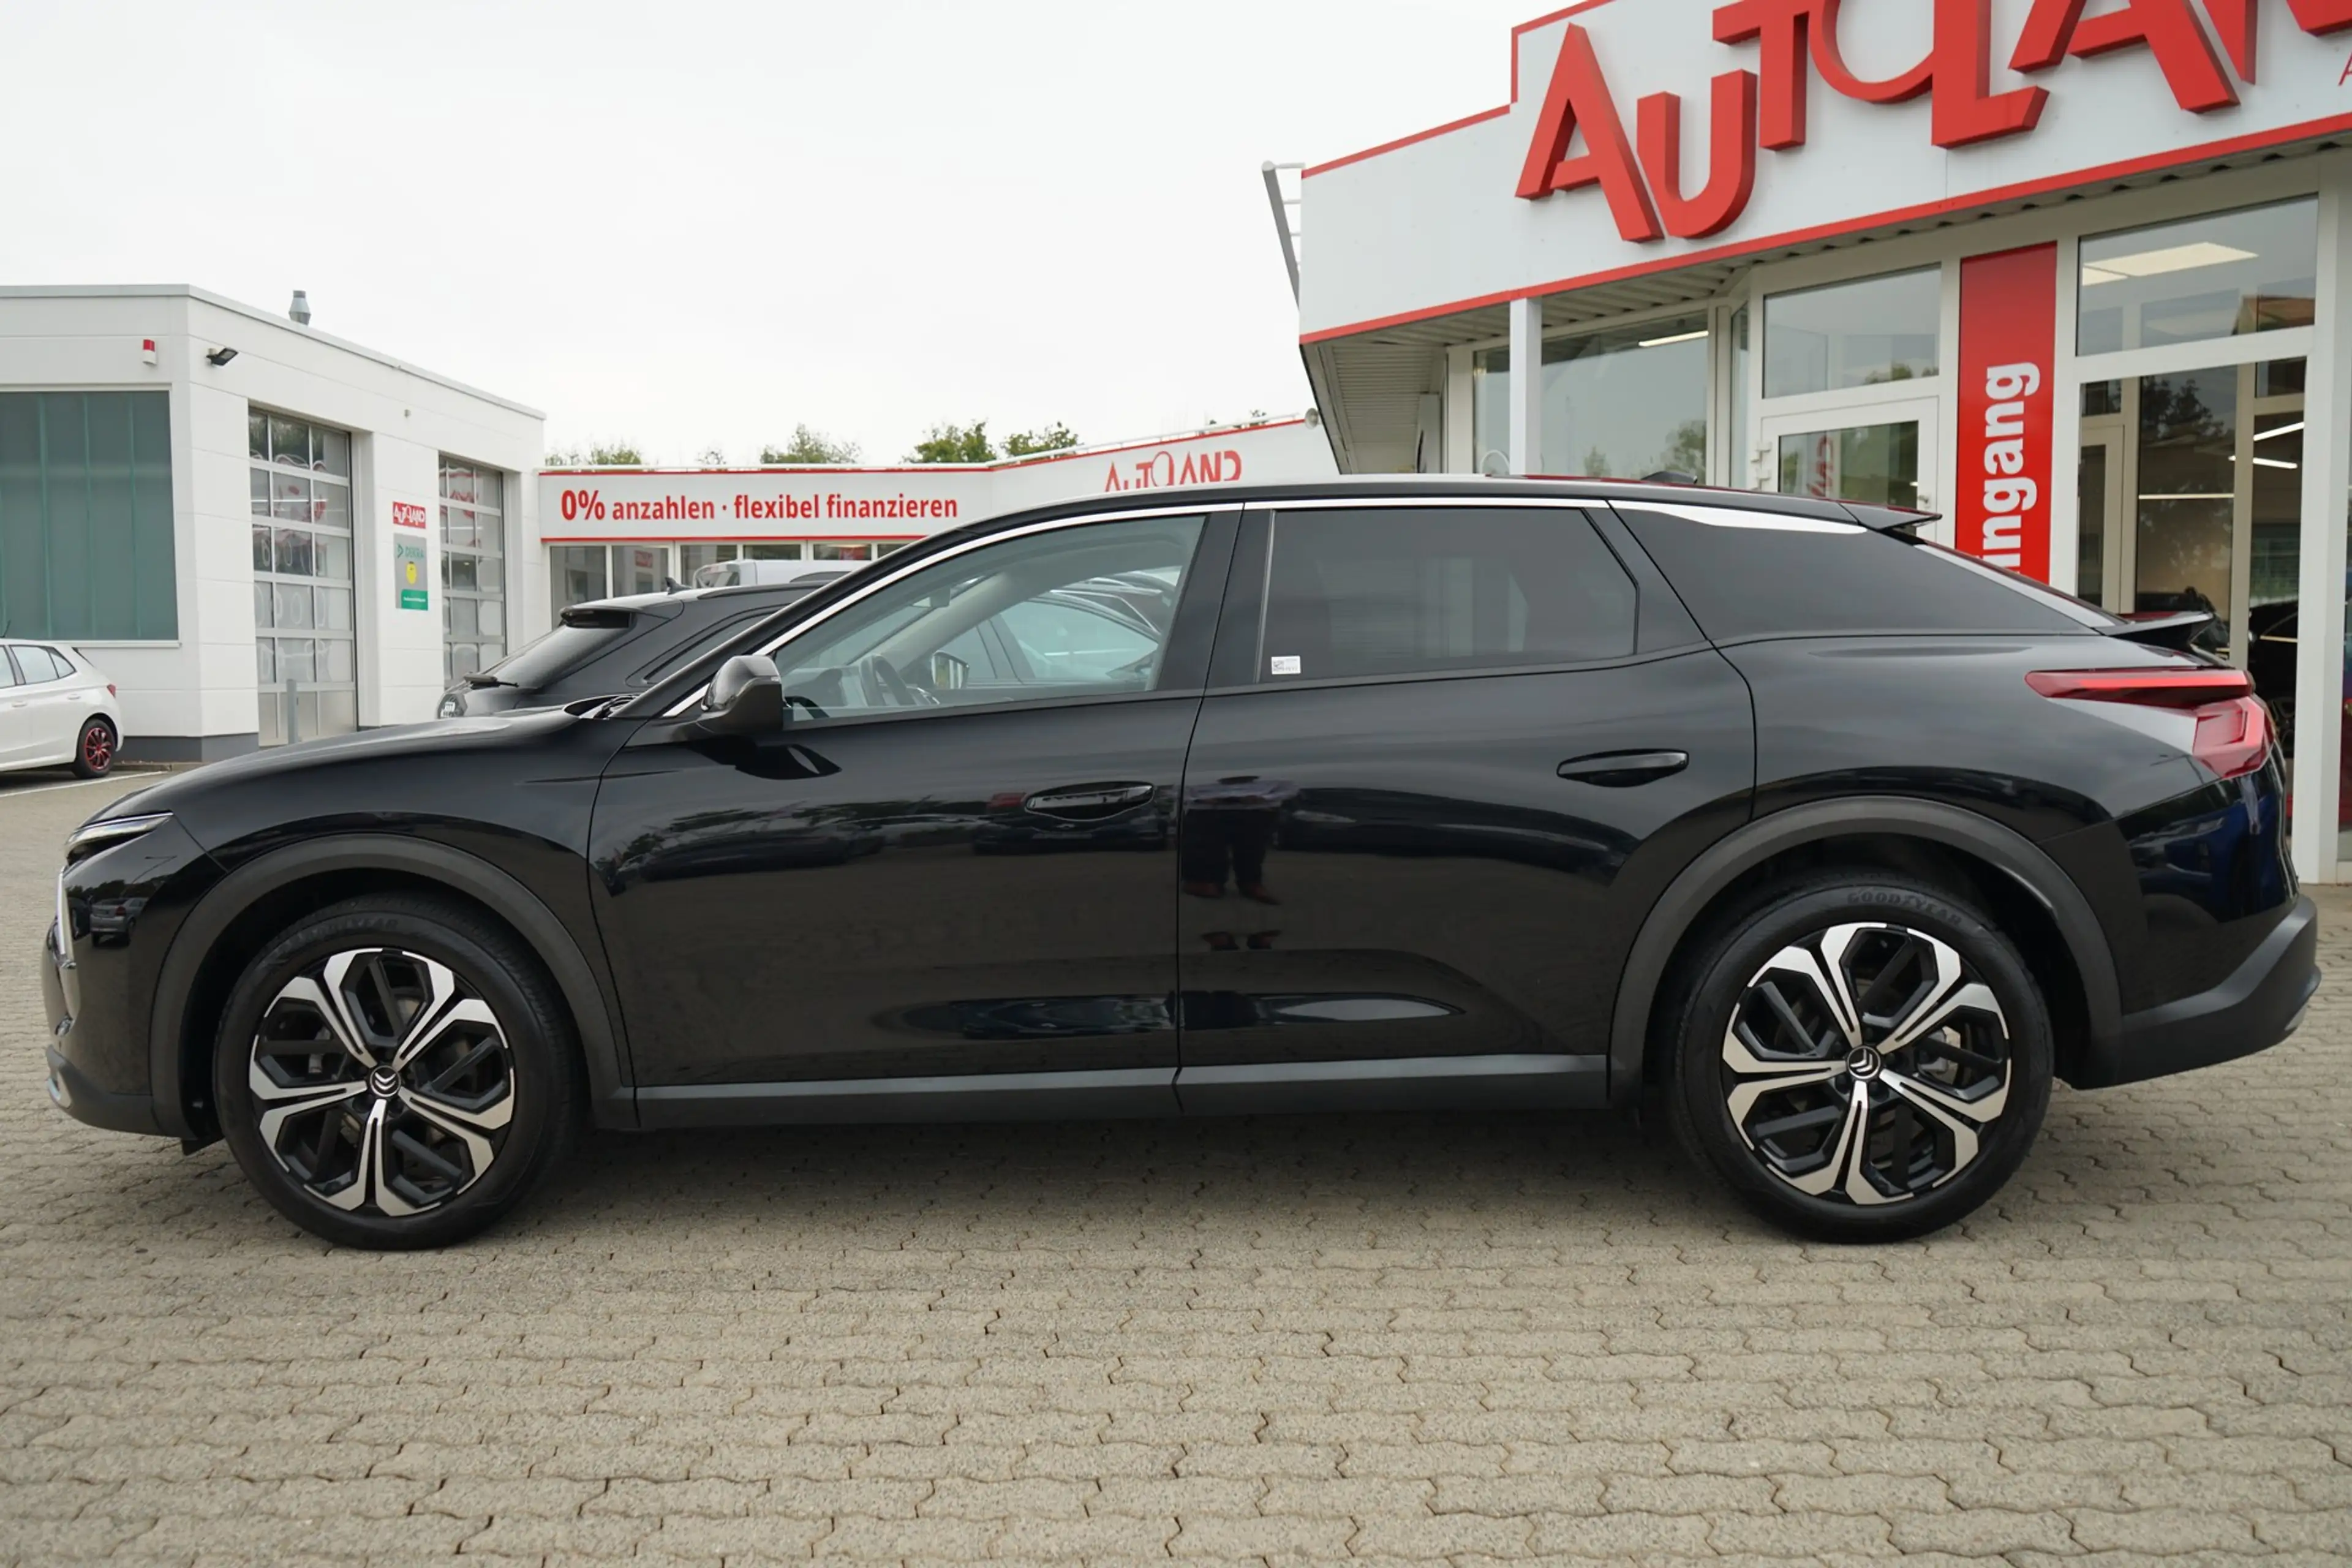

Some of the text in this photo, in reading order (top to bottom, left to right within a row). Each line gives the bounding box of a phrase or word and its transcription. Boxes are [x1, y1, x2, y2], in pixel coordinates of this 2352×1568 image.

[560, 489, 606, 521] 0%
[612, 495, 714, 520] anzahlen
[733, 494, 820, 519] flexibel
[826, 493, 958, 518] finanzieren
[1977, 362, 2040, 574] ingang
